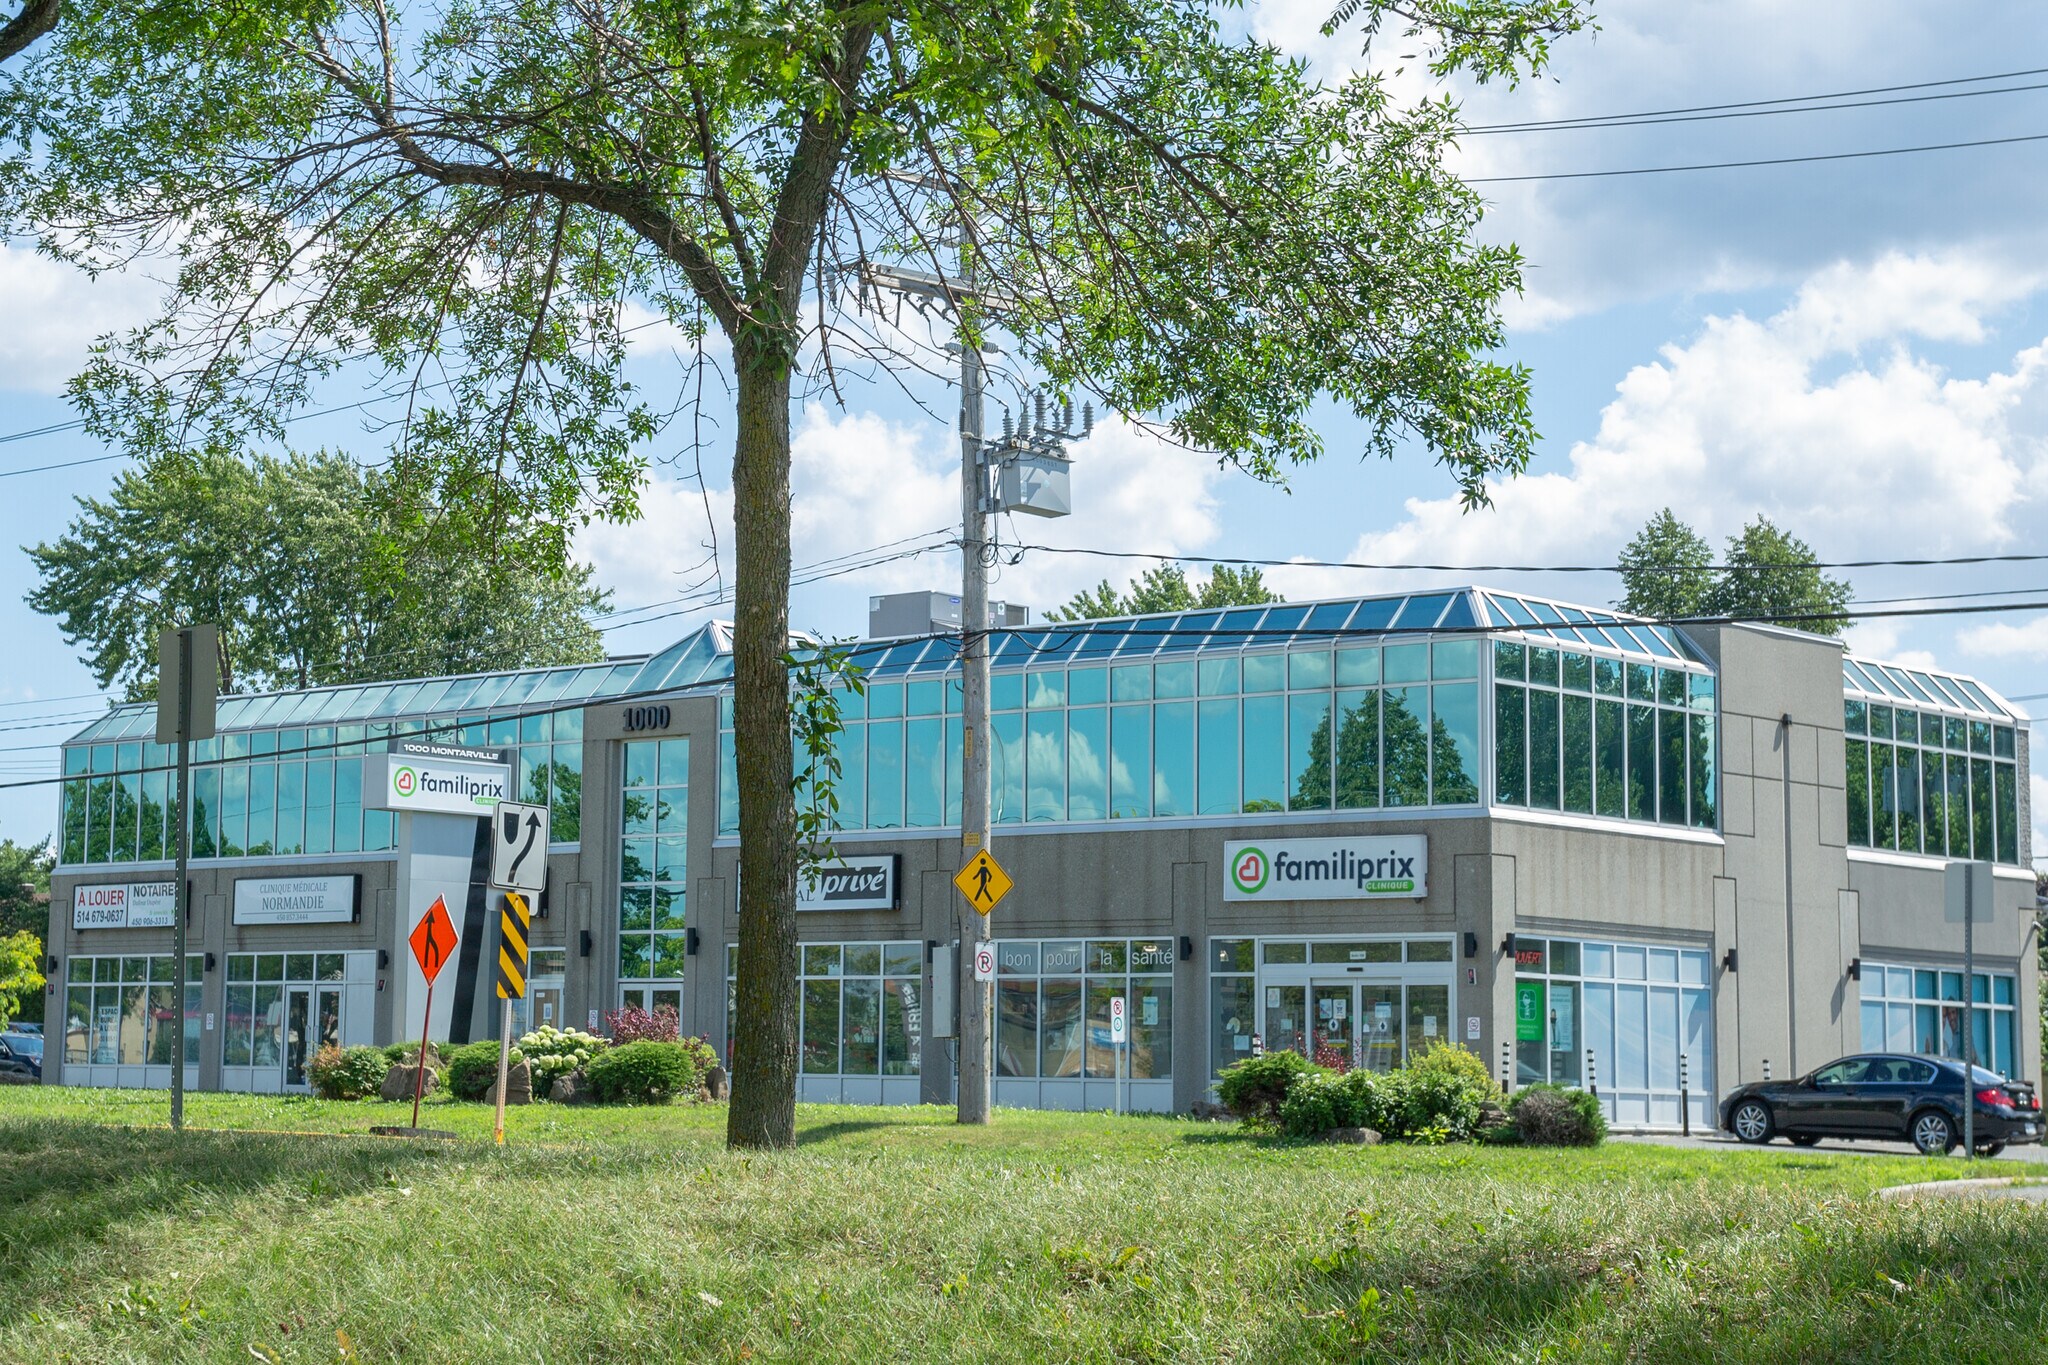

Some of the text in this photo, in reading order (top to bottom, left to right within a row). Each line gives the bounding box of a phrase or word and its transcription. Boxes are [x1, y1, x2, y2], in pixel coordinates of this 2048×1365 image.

[623, 705, 671, 731] 1000
[404, 744, 499, 760] 1000 MONTARVILLE
[420, 772, 503, 801] familiprix
[1274, 849, 1415, 889] familiprix
[133, 884, 175, 897] NOTAIRE
[260, 881, 328, 895] CLINIQUE MÉDICALE
[822, 866, 887, 900] privé
[1366, 881, 1409, 890] CLINIQUE
[78, 887, 86, 907] À
[88, 890, 125, 906] LOUER
[262, 895, 325, 911] NORMANDIE
[77, 909, 124, 923] 514 679-0637
[1005, 948, 1173, 969] bon pour la santé
